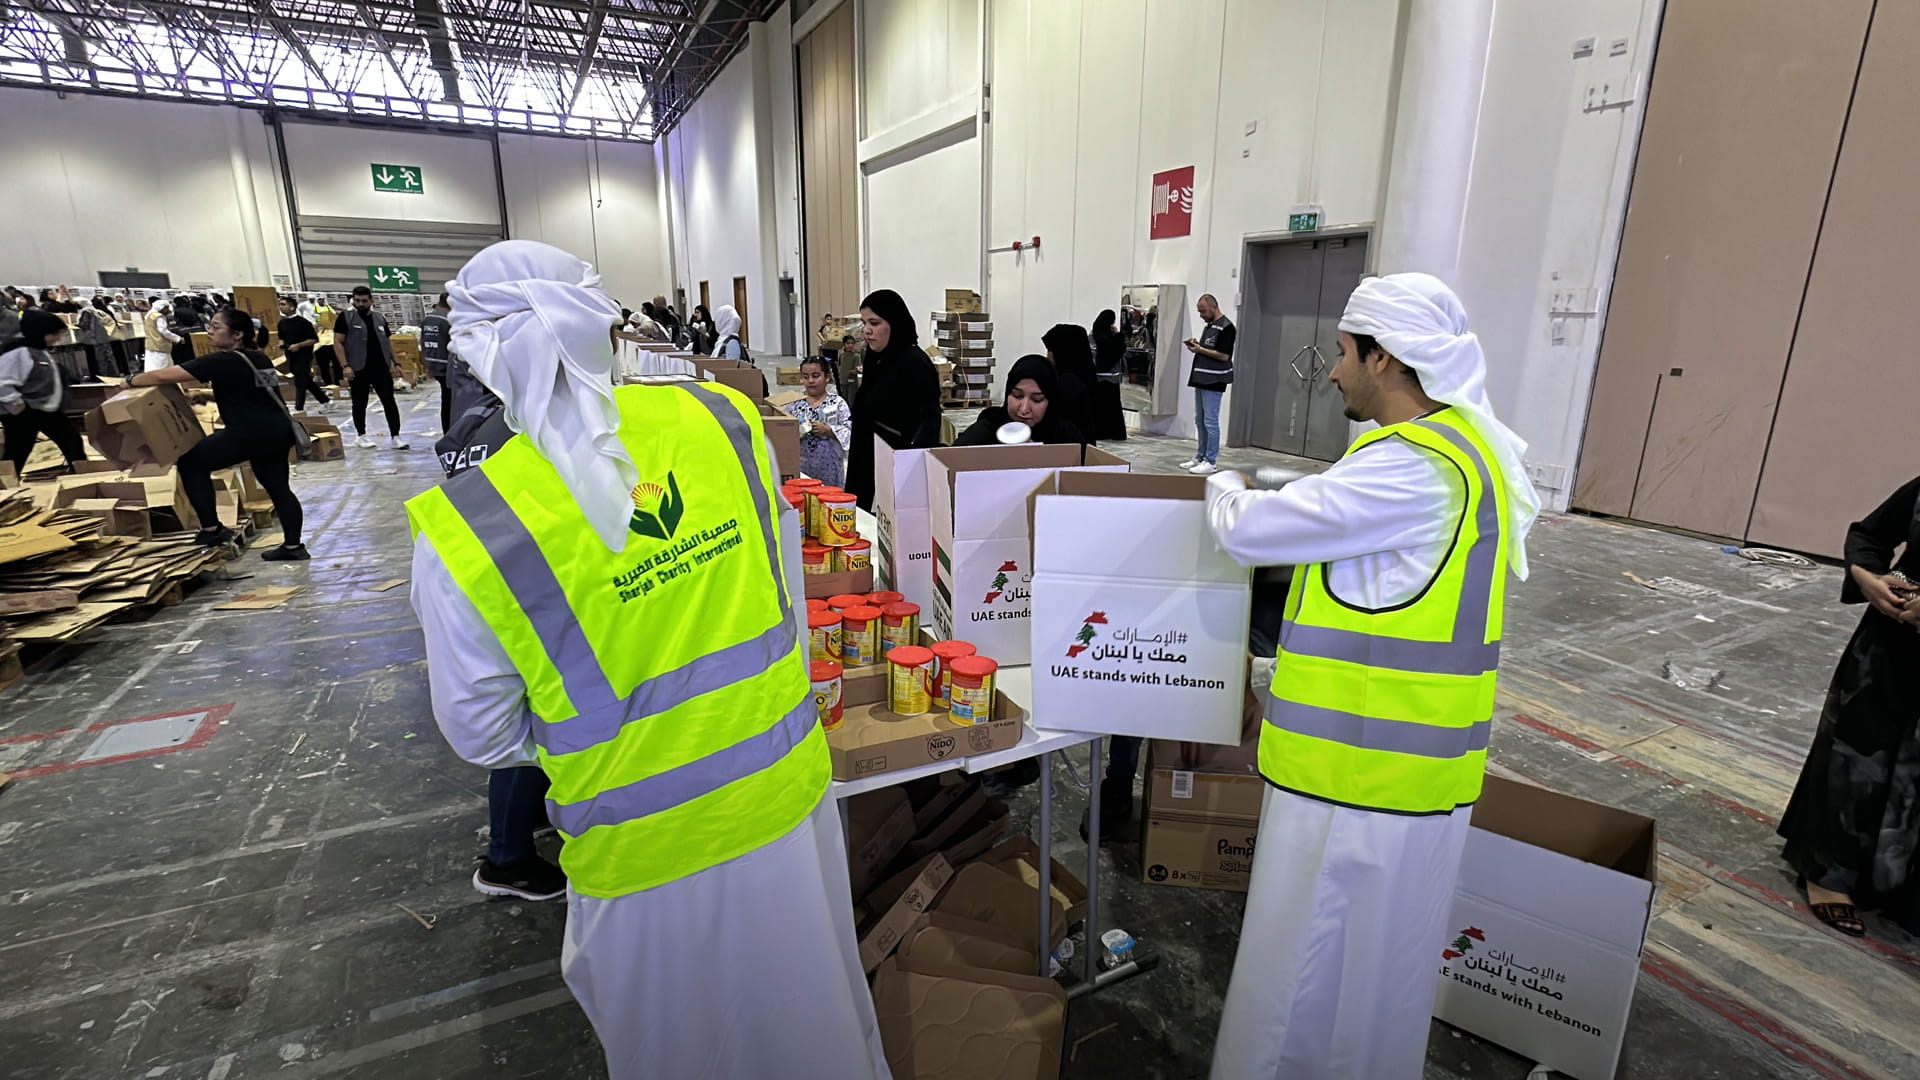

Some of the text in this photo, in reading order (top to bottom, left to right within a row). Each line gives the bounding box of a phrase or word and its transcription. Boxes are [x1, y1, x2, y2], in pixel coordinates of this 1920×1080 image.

[613, 518, 738, 588] جمعية الشارقة الخيرية
[619, 531, 743, 603] Sharjah Charity International
[971, 610, 995, 622] UAE
[1091, 644, 1188, 664] معك يا لبنان
[1051, 665, 1225, 690] UAE stands with Lebanon
[930, 739, 952, 750] NIDO
[1464, 956, 1563, 1001] معك يا لبنان
[1453, 972, 1497, 996] stands
[1501, 991, 1534, 1011] with
[1537, 1004, 1602, 1037] Lebanon
